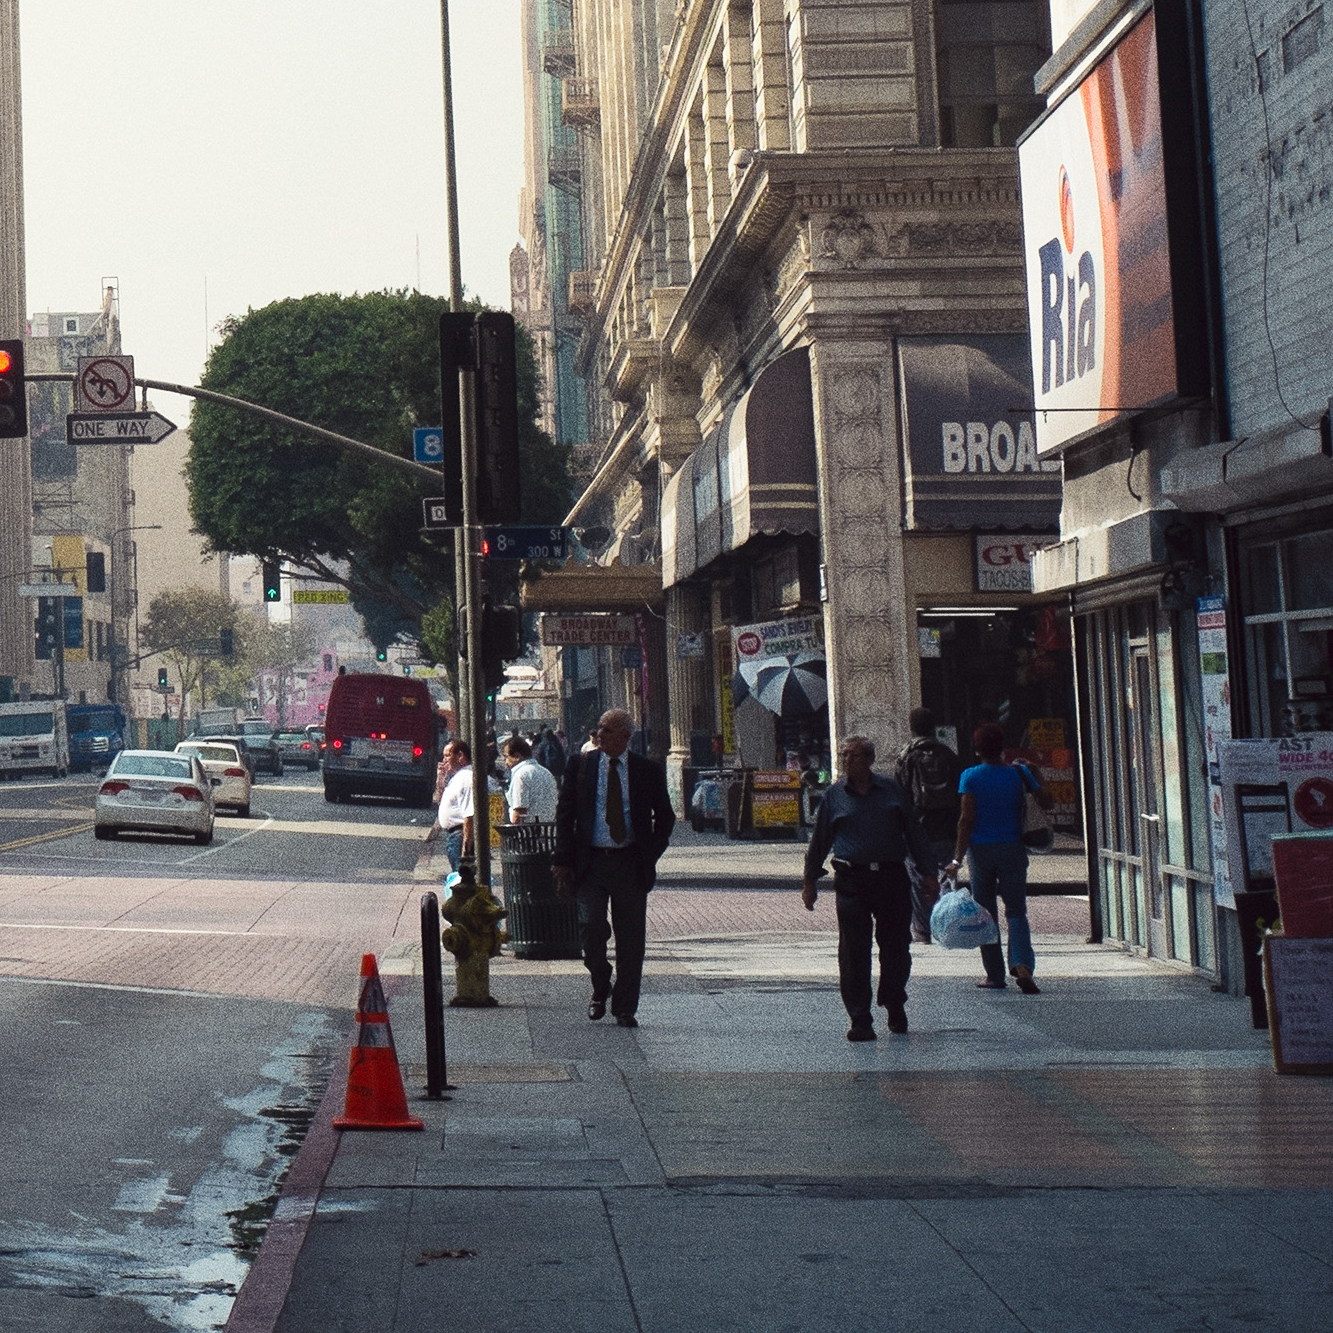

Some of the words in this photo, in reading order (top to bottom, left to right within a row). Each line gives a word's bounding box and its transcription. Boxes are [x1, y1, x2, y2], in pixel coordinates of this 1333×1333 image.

[1039, 164, 1095, 395] Ria
[74, 422, 105, 436] ONE
[117, 421, 148, 436] WAY
[942, 420, 1061, 473] BROA
[550, 528, 562, 540] St
[528, 546, 549, 557] 300
[553, 546, 562, 557] W
[298, 591, 317, 602] PED
[321, 592, 345, 602] XING
[561, 618, 618, 630] BROADWAY
[550, 630, 585, 642] TRADE
[589, 630, 630, 642] CENTER
